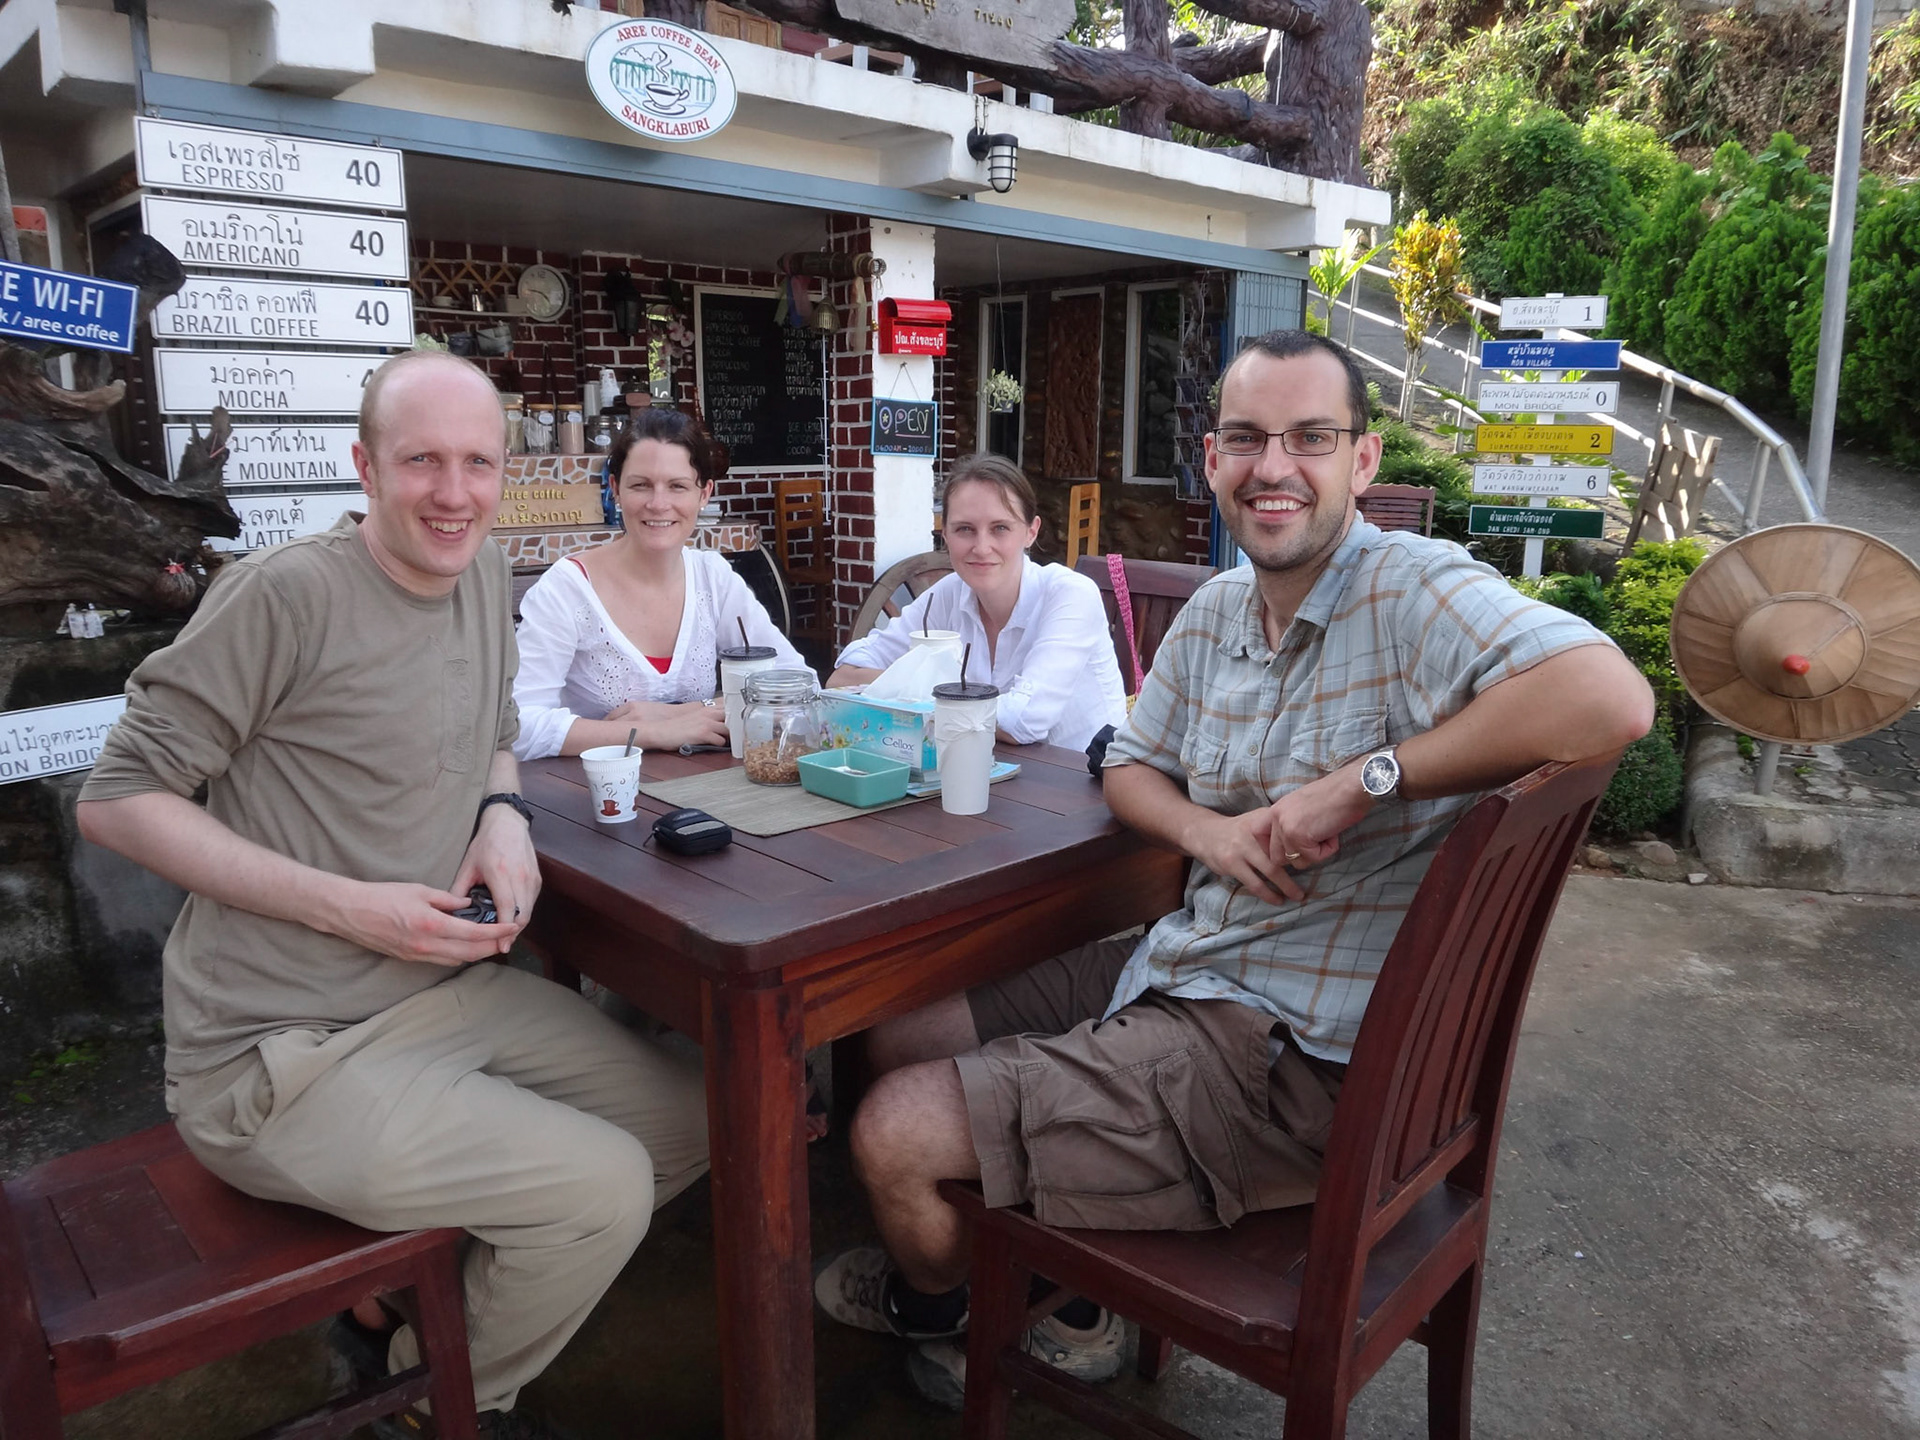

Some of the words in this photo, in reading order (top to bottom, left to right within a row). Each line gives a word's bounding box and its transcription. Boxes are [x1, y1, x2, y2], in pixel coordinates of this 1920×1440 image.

[618, 25, 647, 42] AREE
[651, 25, 693, 48] COFFEE
[693, 42, 721, 70] BEAN
[621, 104, 710, 136] SANGKLABURI
[182, 164, 284, 192] ESPRESSO
[346, 159, 381, 187] 40
[183, 240, 299, 267] AMERICANO
[350, 229, 384, 257] 40
[0, 270, 20, 302] E
[33, 277, 104, 318] WI-FI
[355, 300, 389, 326] 40
[1583, 306, 1592, 321] 1
[22, 315, 62, 333] aree
[65, 323, 120, 343] coffee
[172, 314, 243, 335] BRAZIL
[251, 316, 319, 338] COFFEE
[1526, 359, 1552, 367] VILLAGE
[218, 390, 289, 409] MOCHA
[1494, 402, 1520, 410] MON
[1524, 402, 1564, 410] BRIDGE
[1596, 391, 1607, 406] 0
[879, 406, 930, 434] OPEN
[1590, 433, 1601, 448] 2
[239, 461, 337, 481] MOUNTAIN
[1587, 475, 1597, 490] 6
[882, 736, 915, 751] Cellox
